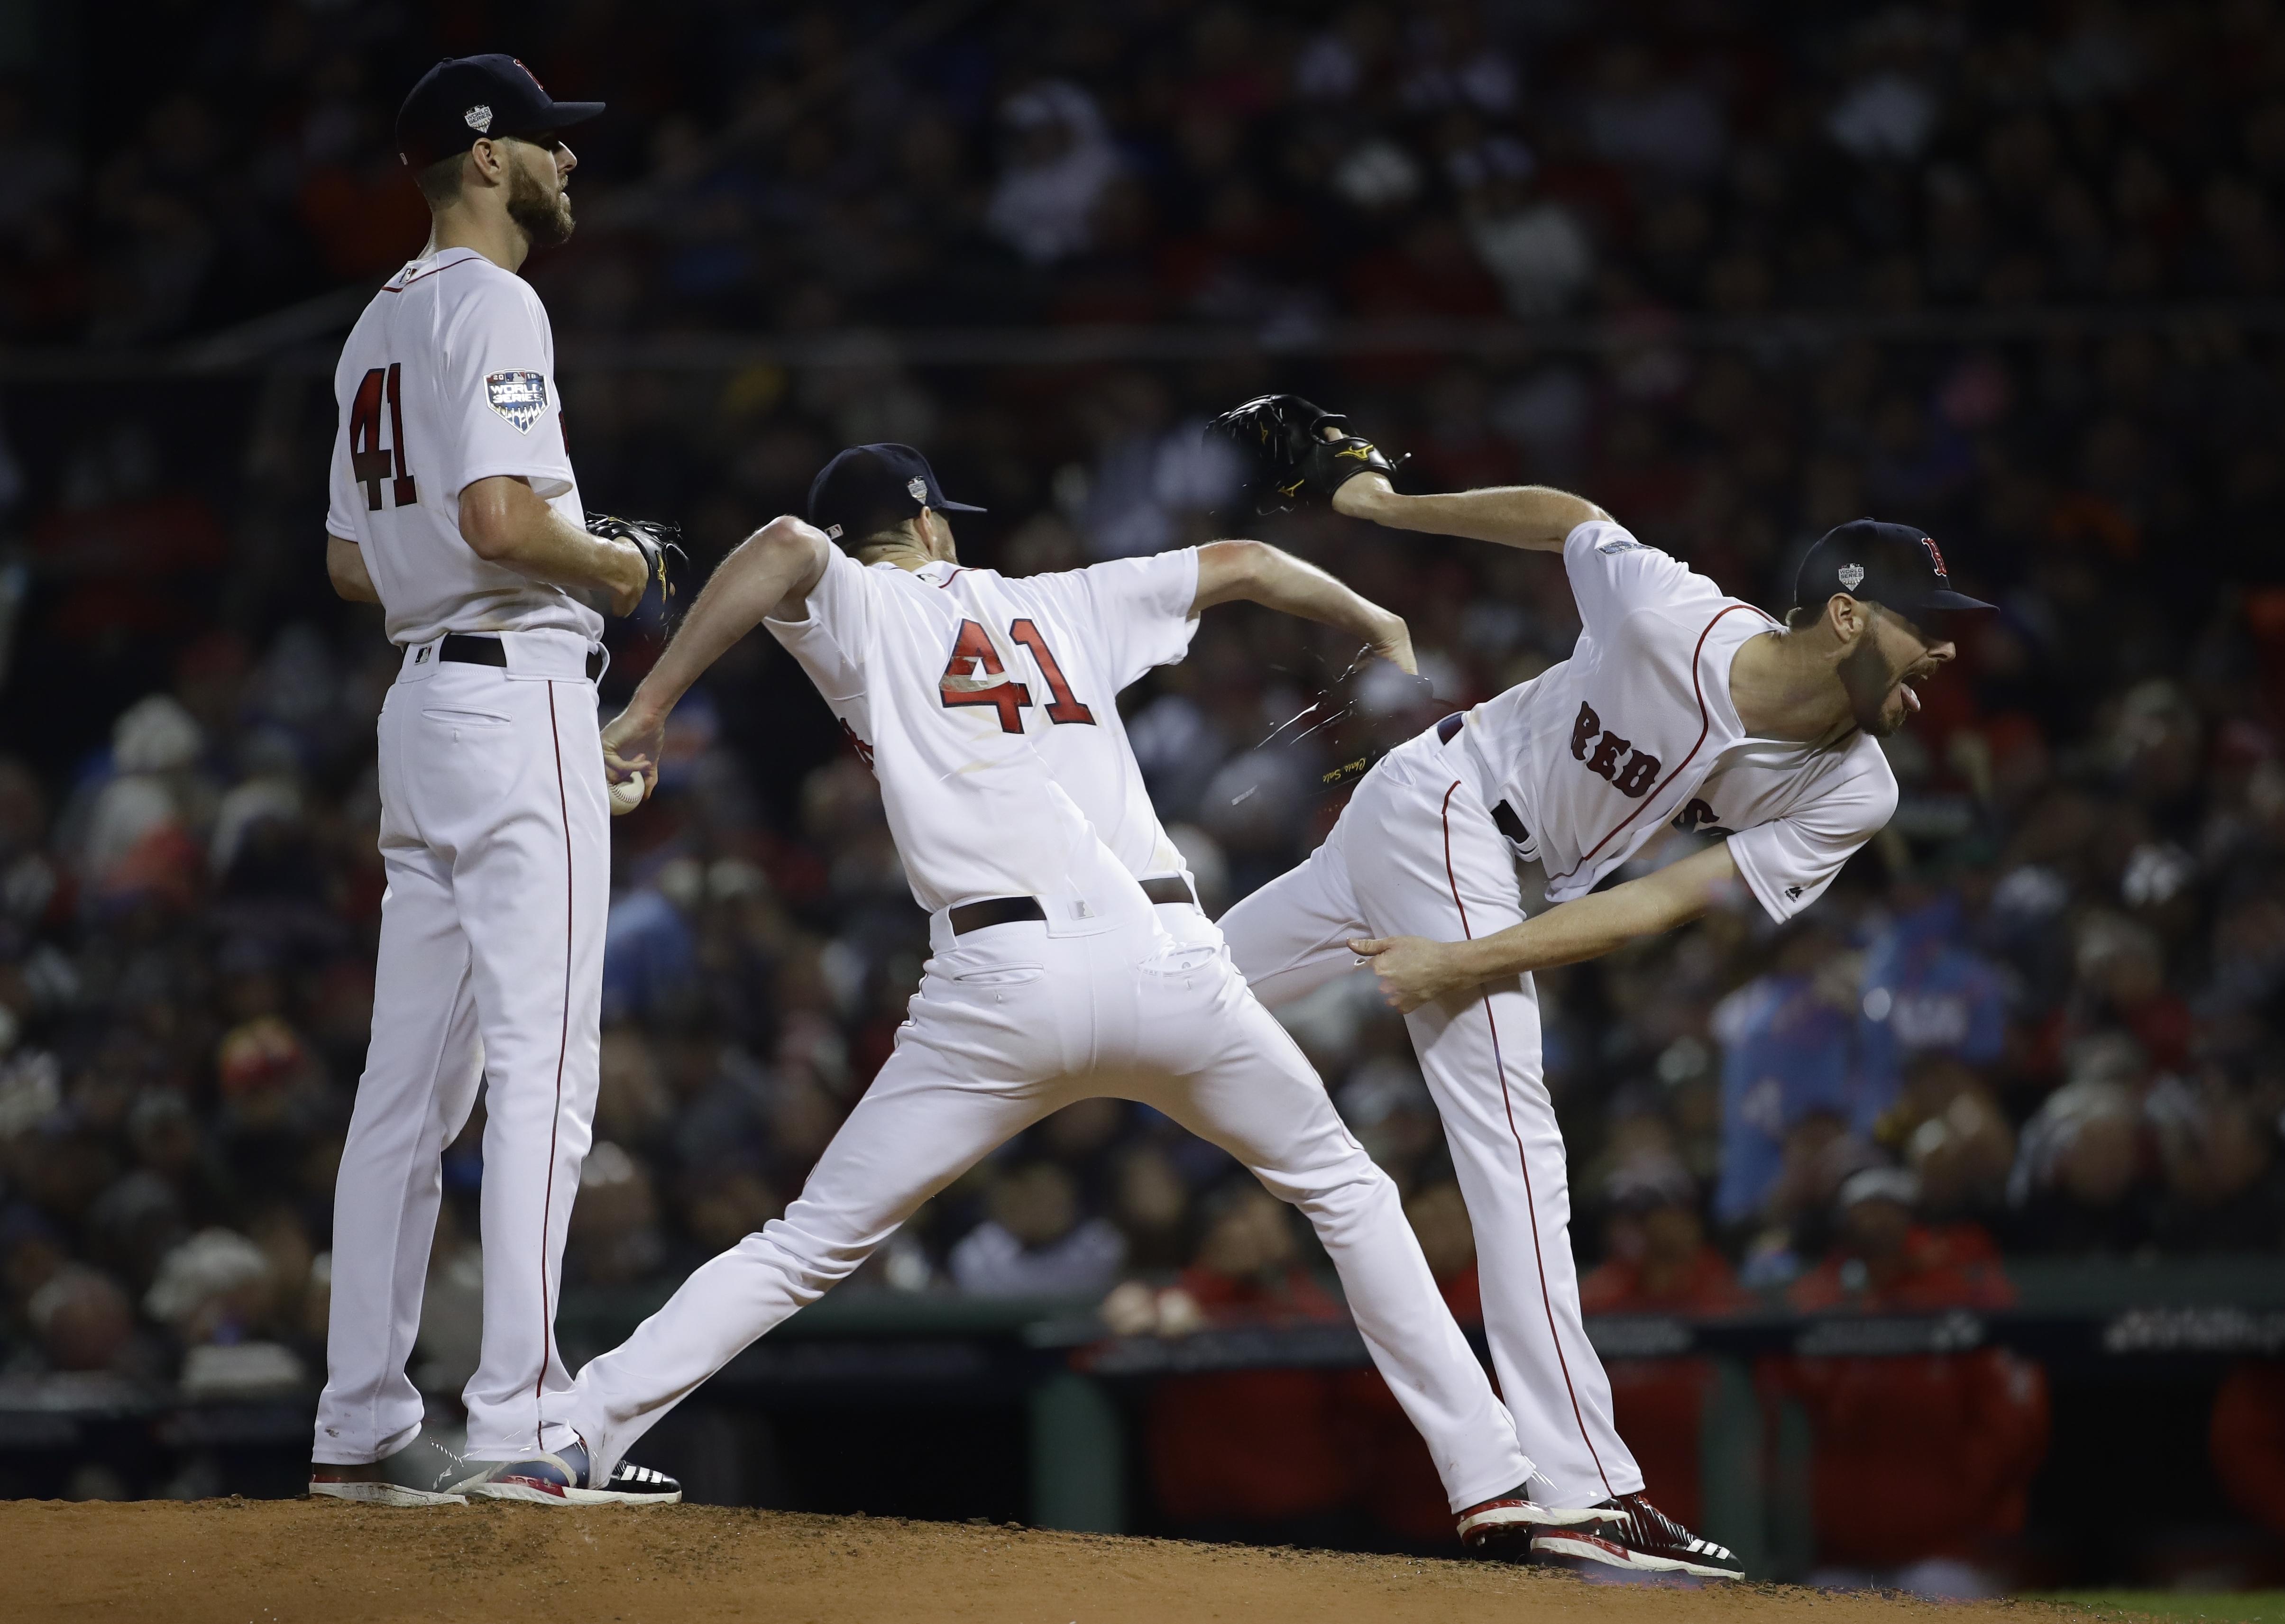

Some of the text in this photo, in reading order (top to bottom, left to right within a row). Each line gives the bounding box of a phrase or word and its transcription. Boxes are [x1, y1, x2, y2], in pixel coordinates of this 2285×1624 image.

[466, 108, 489, 120] WORLD
[469, 112, 490, 124] SERIES
[489, 383, 542, 394] WORLD
[493, 393, 543, 403] SERIES
[349, 362, 417, 511] 41
[938, 618, 1097, 734] 41
[1570, 700, 1661, 798] RED
[1322, 757, 1366, 784] Chris Sale
